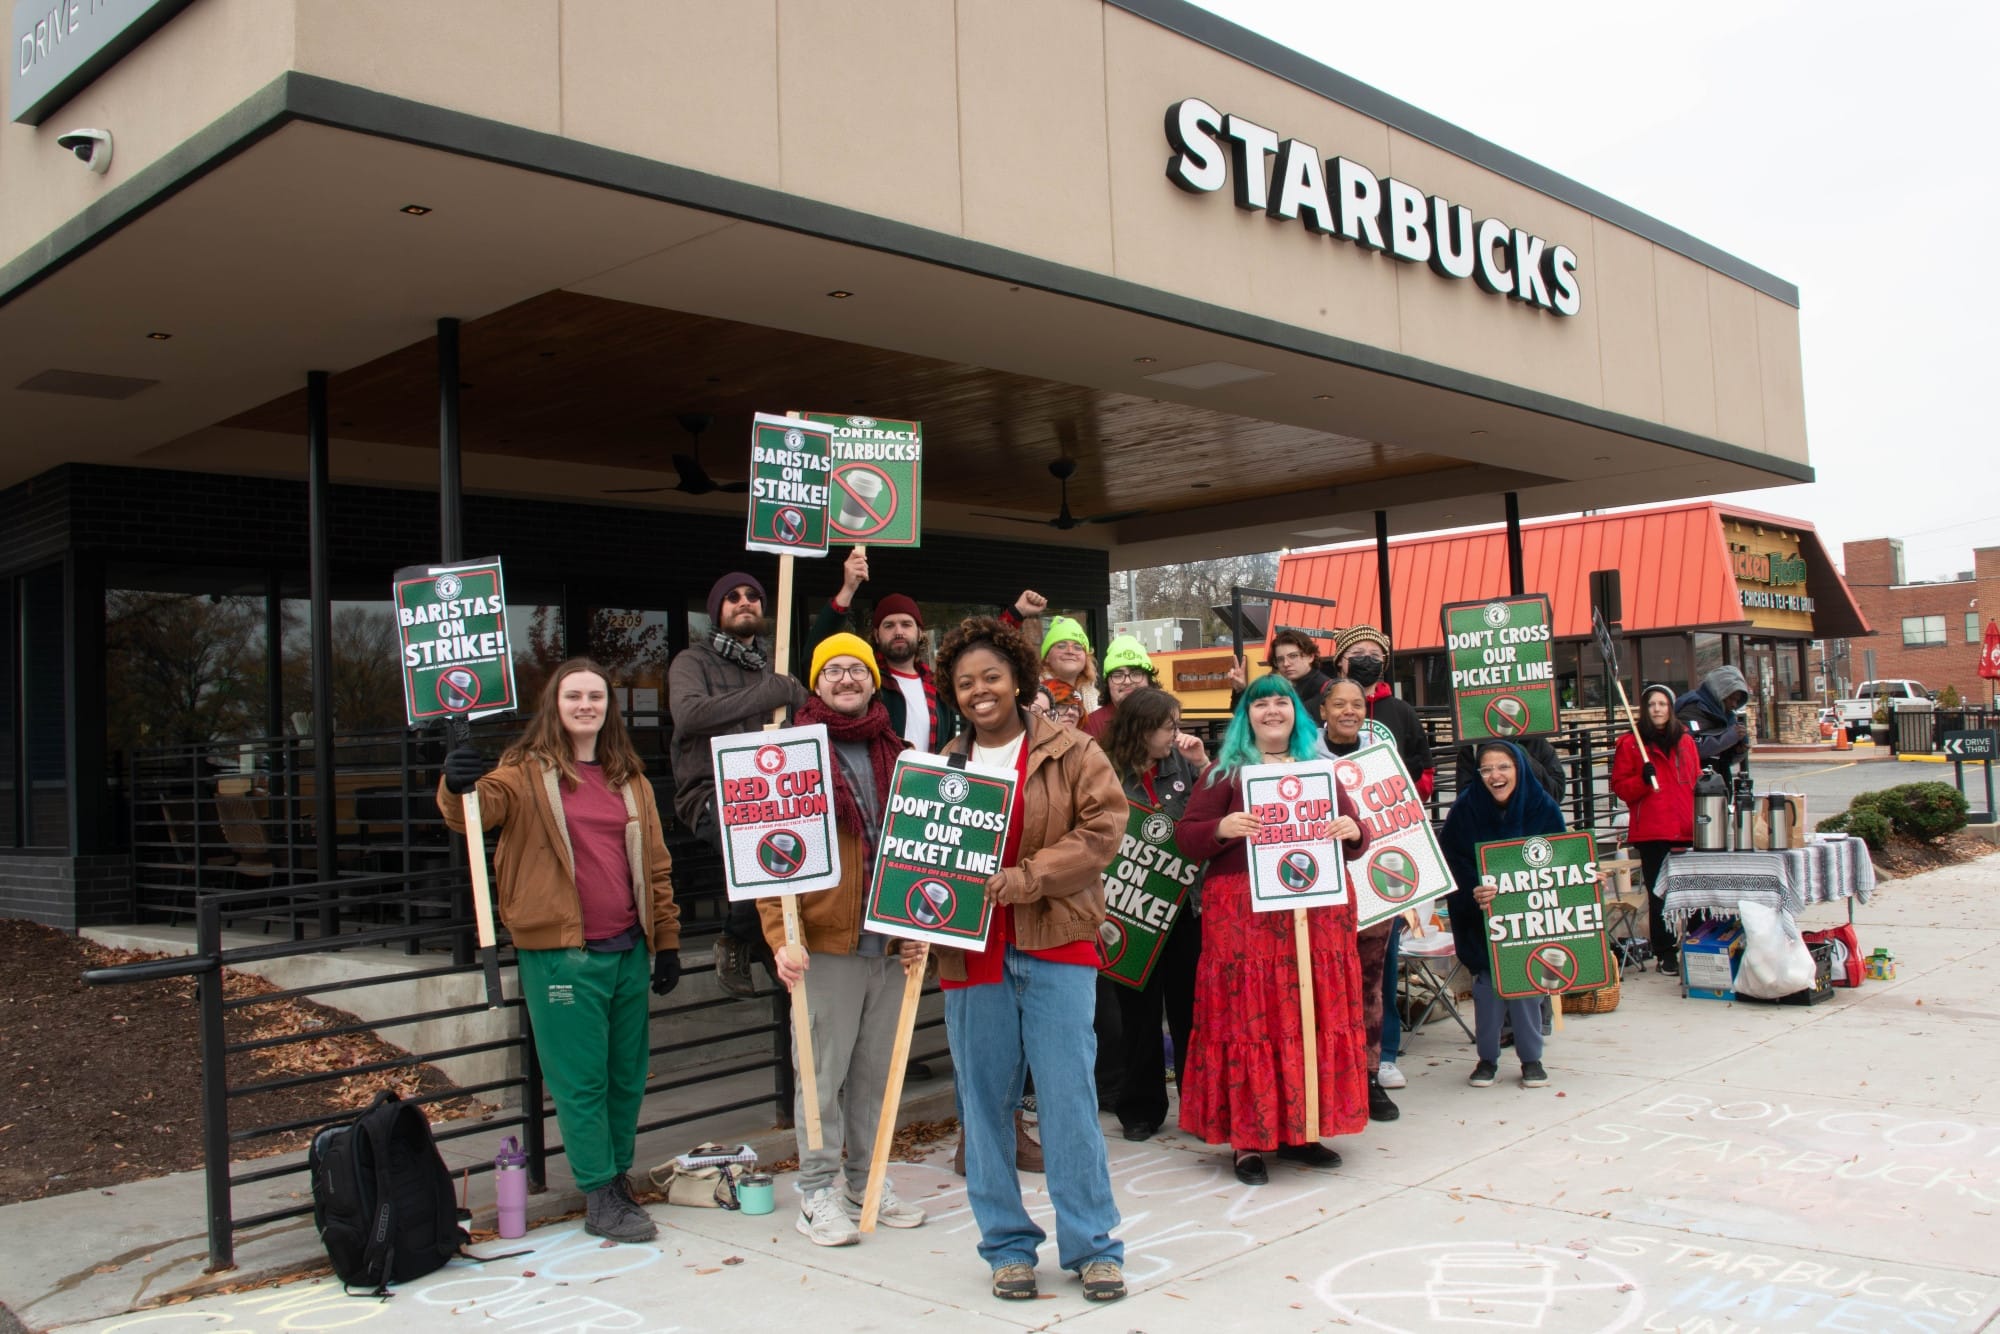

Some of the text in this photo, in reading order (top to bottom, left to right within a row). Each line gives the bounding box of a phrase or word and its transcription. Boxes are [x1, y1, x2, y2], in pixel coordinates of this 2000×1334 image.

[20, 0, 80, 77] DRIVE
[1165, 97, 1581, 316] STARBUCKS
[832, 427, 919, 443] CONTRACT,
[754, 447, 830, 471] BARISTAS
[782, 467, 802, 482] ON
[753, 478, 828, 505] STRIKE!
[1728, 543, 1770, 582] icken
[400, 595, 502, 627] BARISTAS
[438, 619, 466, 637] ON
[1448, 624, 1550, 650] DON'T CROSS
[406, 631, 504, 666] STRIKE!
[1483, 646, 1517, 665] OUR
[1452, 661, 1554, 688] PICKET LINE
[1360, 722, 1389, 740] BUCKS
[1965, 738, 1991, 746] DRIVE
[1966, 745, 1989, 753] THRU
[723, 769, 822, 803] RED CUP
[1361, 774, 1408, 812] CUP
[723, 793, 828, 826] REBELLION
[891, 794, 1005, 832] DON'T CROSS
[1251, 803, 1289, 825] RED
[1295, 799, 1332, 822] CUP
[1362, 799, 1425, 840] LLION
[925, 822, 963, 846] OUR
[1250, 821, 1330, 845] EBELLIO
[883, 836, 998, 875] PICKET LINE
[1118, 833, 1199, 885] RISTAS
[1117, 860, 1149, 887] ON
[1481, 862, 1597, 894] BARISTAS
[1100, 872, 1178, 930] RIKE!
[1527, 890, 1559, 910] ON
[1488, 903, 1604, 941] STRIKE!
[1640, 1094, 2000, 1157] BOYCO
[1594, 1235, 1986, 1318] STARBUCKS
